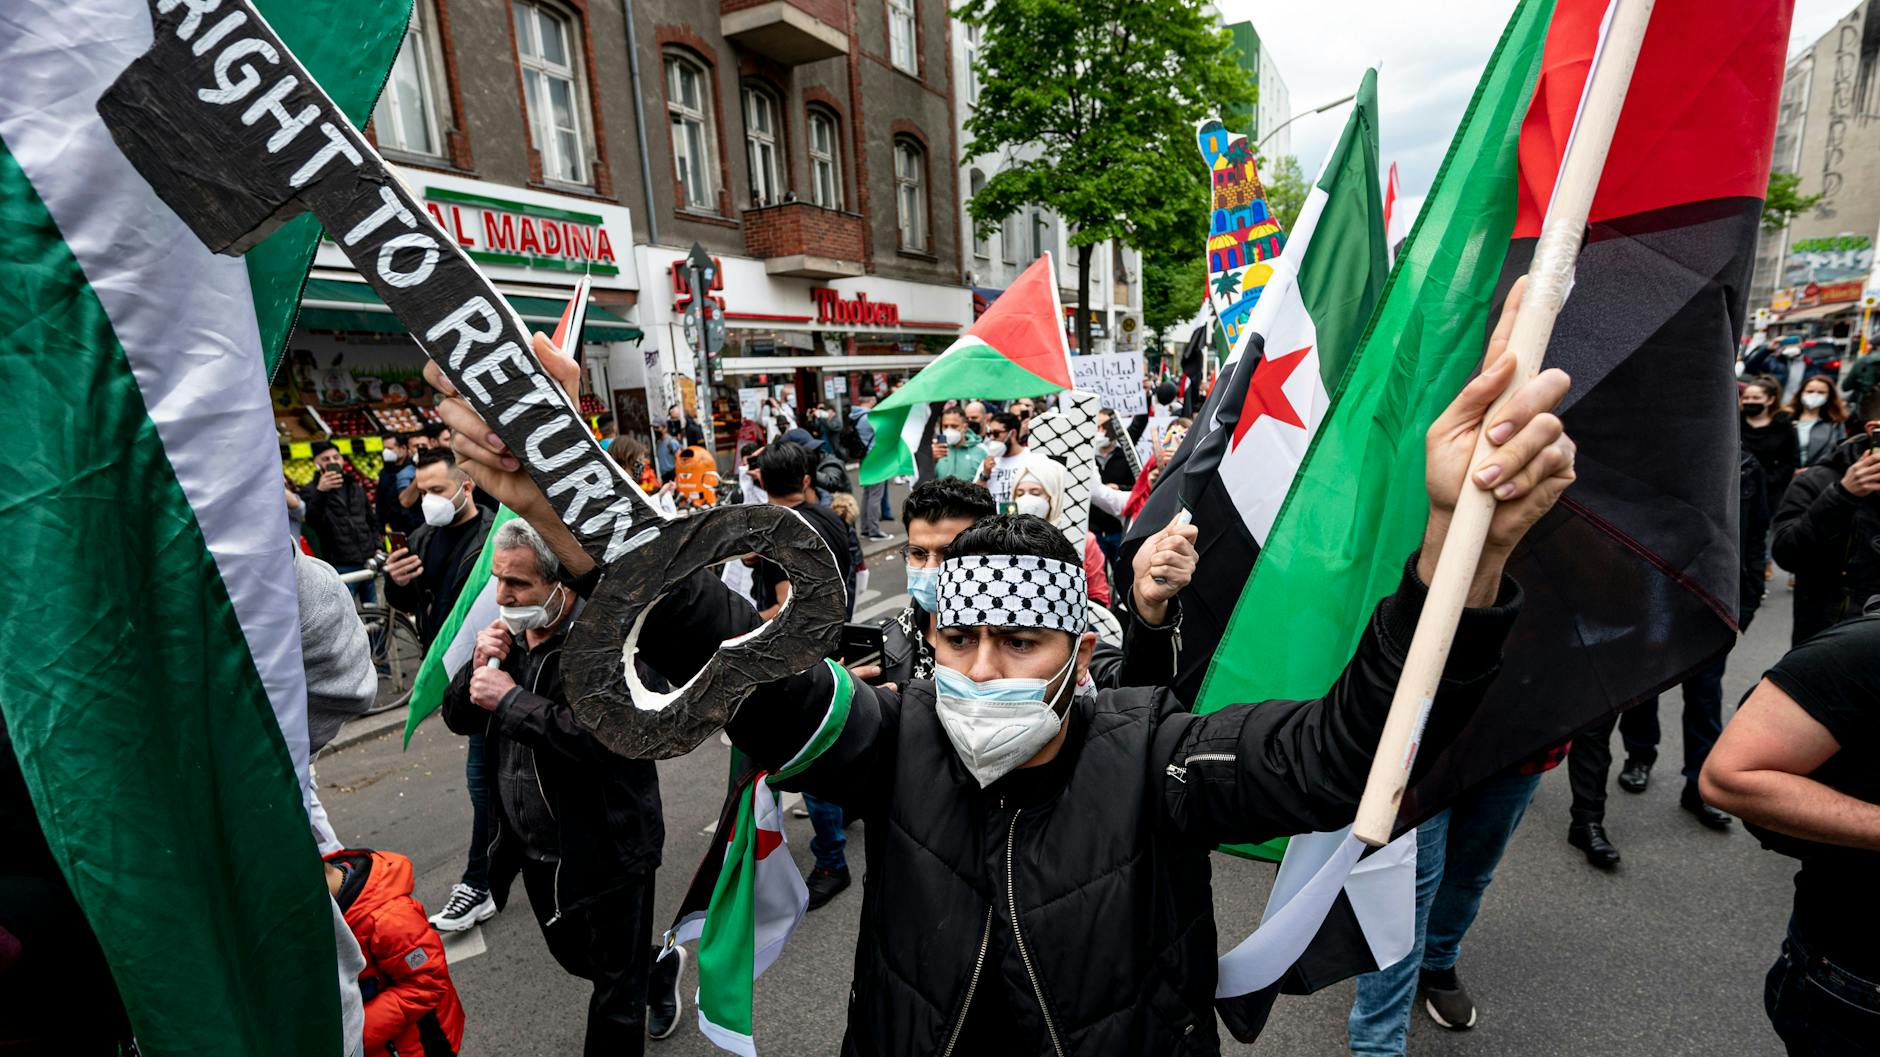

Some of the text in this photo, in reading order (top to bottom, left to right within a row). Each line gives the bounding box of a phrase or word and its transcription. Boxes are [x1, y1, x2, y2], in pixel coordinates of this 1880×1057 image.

[483, 210, 616, 263] MADINA
[810, 286, 900, 326] Thoben
[343, 186, 441, 288] TO
[425, 295, 661, 565] RETURN
[997, 468, 1018, 481] PUS
[1119, 434, 1142, 480] PALESTIN
